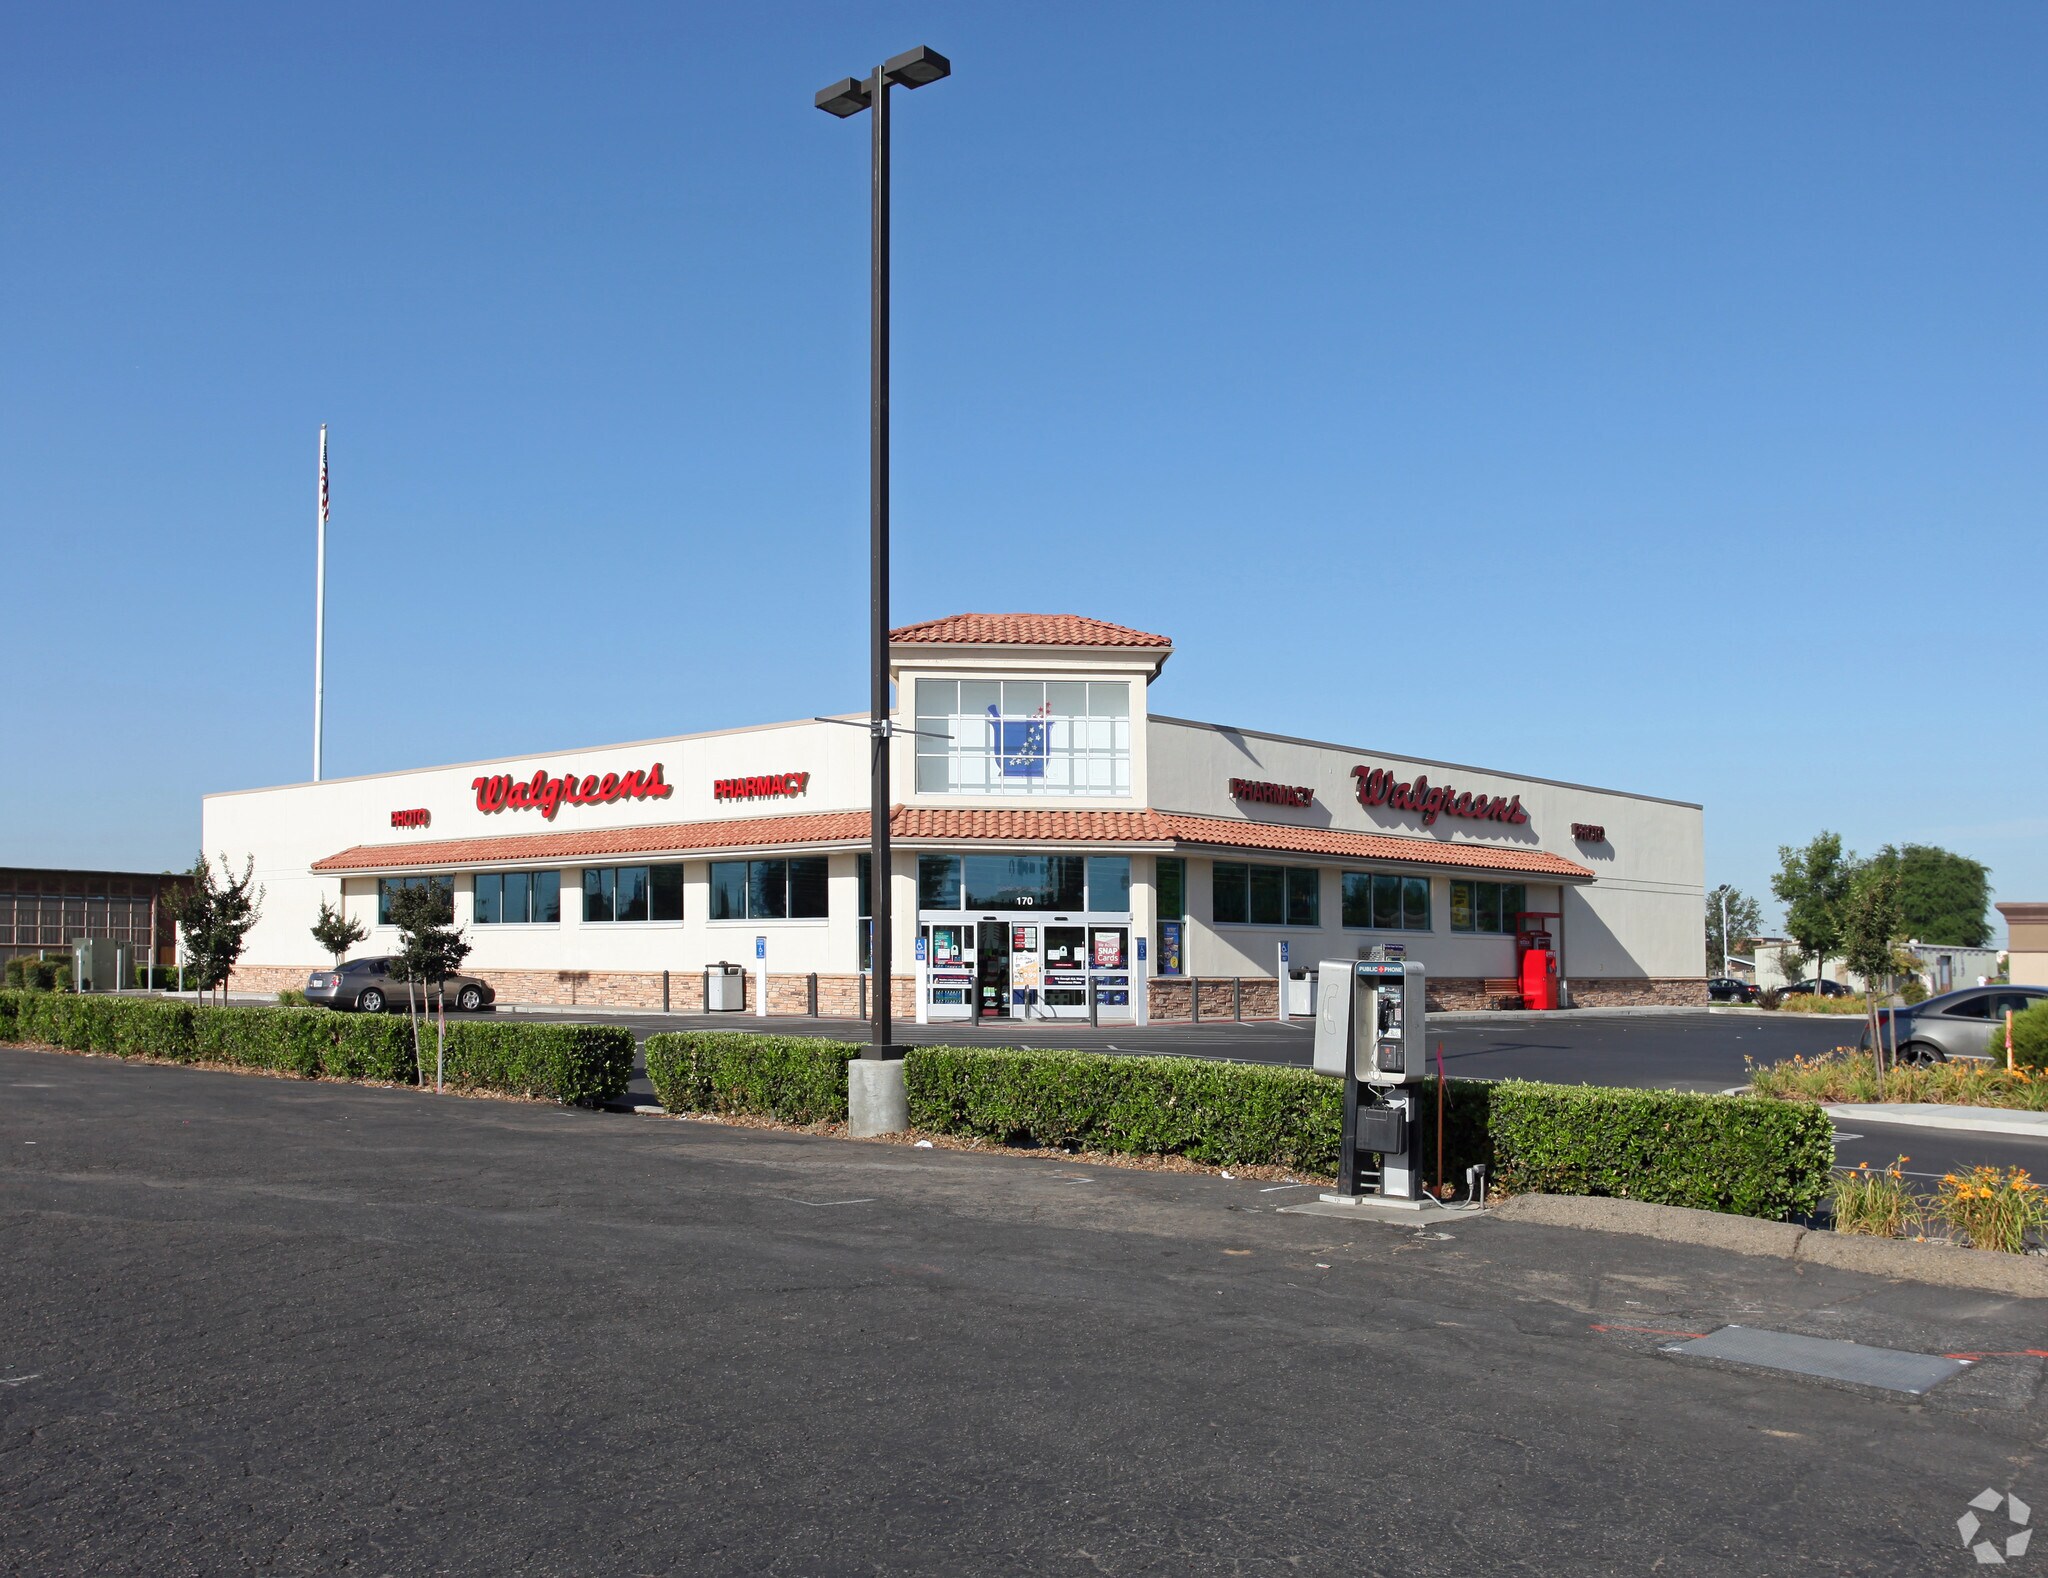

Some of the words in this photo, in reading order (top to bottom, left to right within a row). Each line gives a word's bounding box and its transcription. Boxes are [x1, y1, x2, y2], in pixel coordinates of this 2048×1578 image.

[472, 763, 671, 818] Walgreens
[714, 772, 808, 799] PHARMACY
[1229, 778, 1314, 807] PHARMACY
[1350, 765, 1527, 825] Walgreens
[391, 808, 427, 827] PHOTO
[1571, 823, 1605, 842] PHOTO
[1016, 896, 1033, 905] 170
